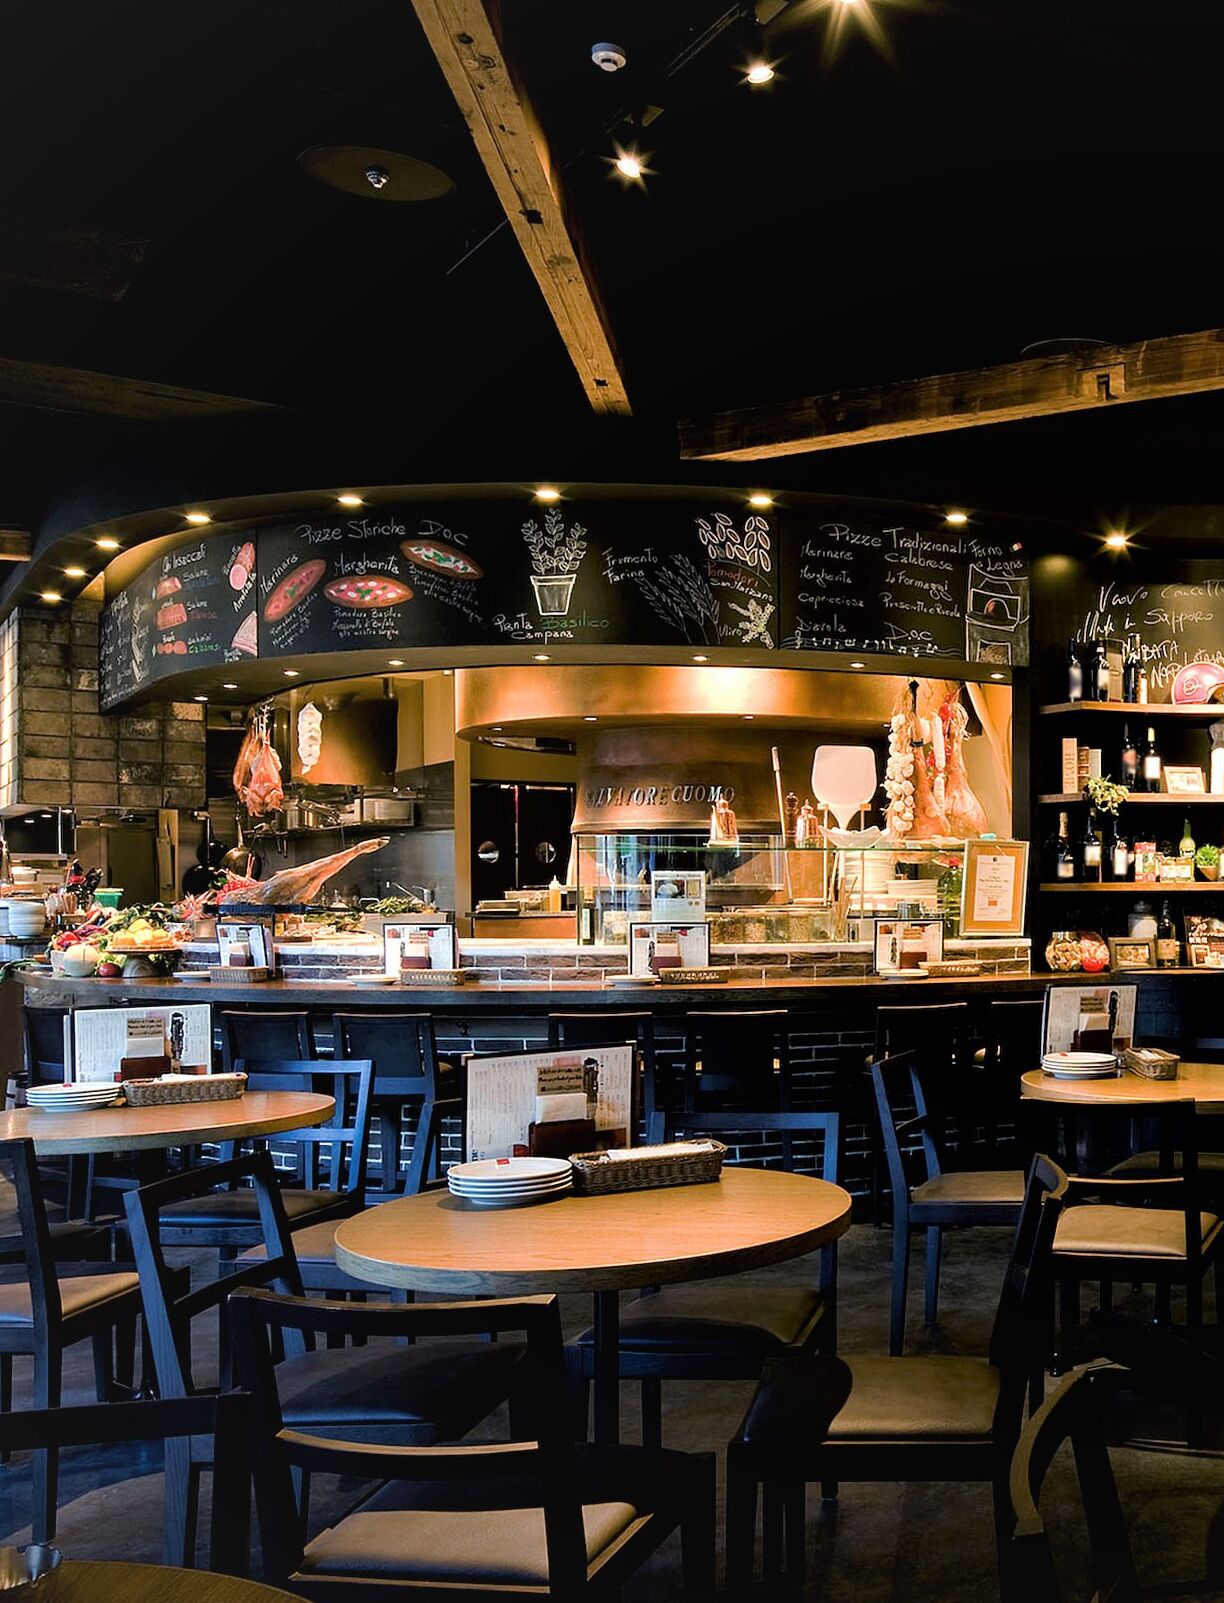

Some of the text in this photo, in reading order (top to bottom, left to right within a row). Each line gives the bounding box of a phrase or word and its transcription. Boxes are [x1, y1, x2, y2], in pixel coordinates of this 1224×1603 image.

[295, 524, 343, 545] Pizze
[819, 523, 967, 554] Pizze Tradizionali
[800, 540, 853, 560] Marinara
[884, 552, 953, 571] Calabrese
[260, 553, 299, 599] Marinara
[602, 568, 645, 585] Farina
[540, 609, 610, 630] Basilico
[1143, 608, 1214, 634] Sapporo
[511, 629, 574, 646] Campana
[671, 784, 735, 804] CUOMO
